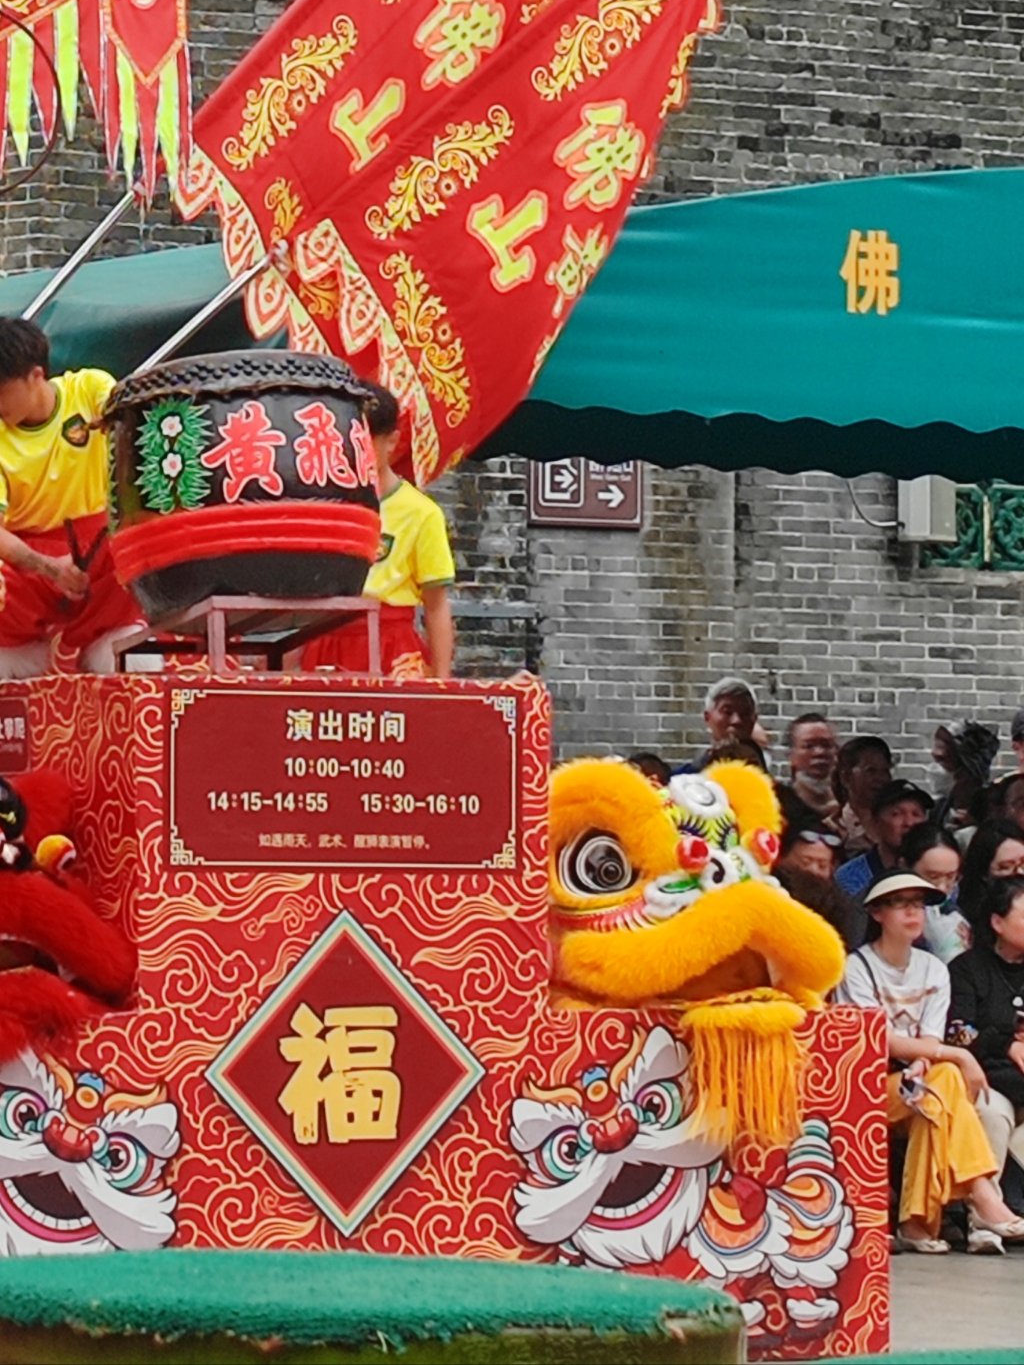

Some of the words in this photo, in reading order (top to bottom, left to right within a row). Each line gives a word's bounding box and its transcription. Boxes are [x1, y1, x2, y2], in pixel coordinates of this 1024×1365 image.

[839, 230, 900, 316] 佛
[285, 708, 407, 743] 演出时间
[284, 756, 406, 780] 10:00-10:40
[207, 790, 329, 813] 14:15-14:55
[359, 792, 481, 815] 15:30-16:10
[278, 1002, 402, 1145] 福
